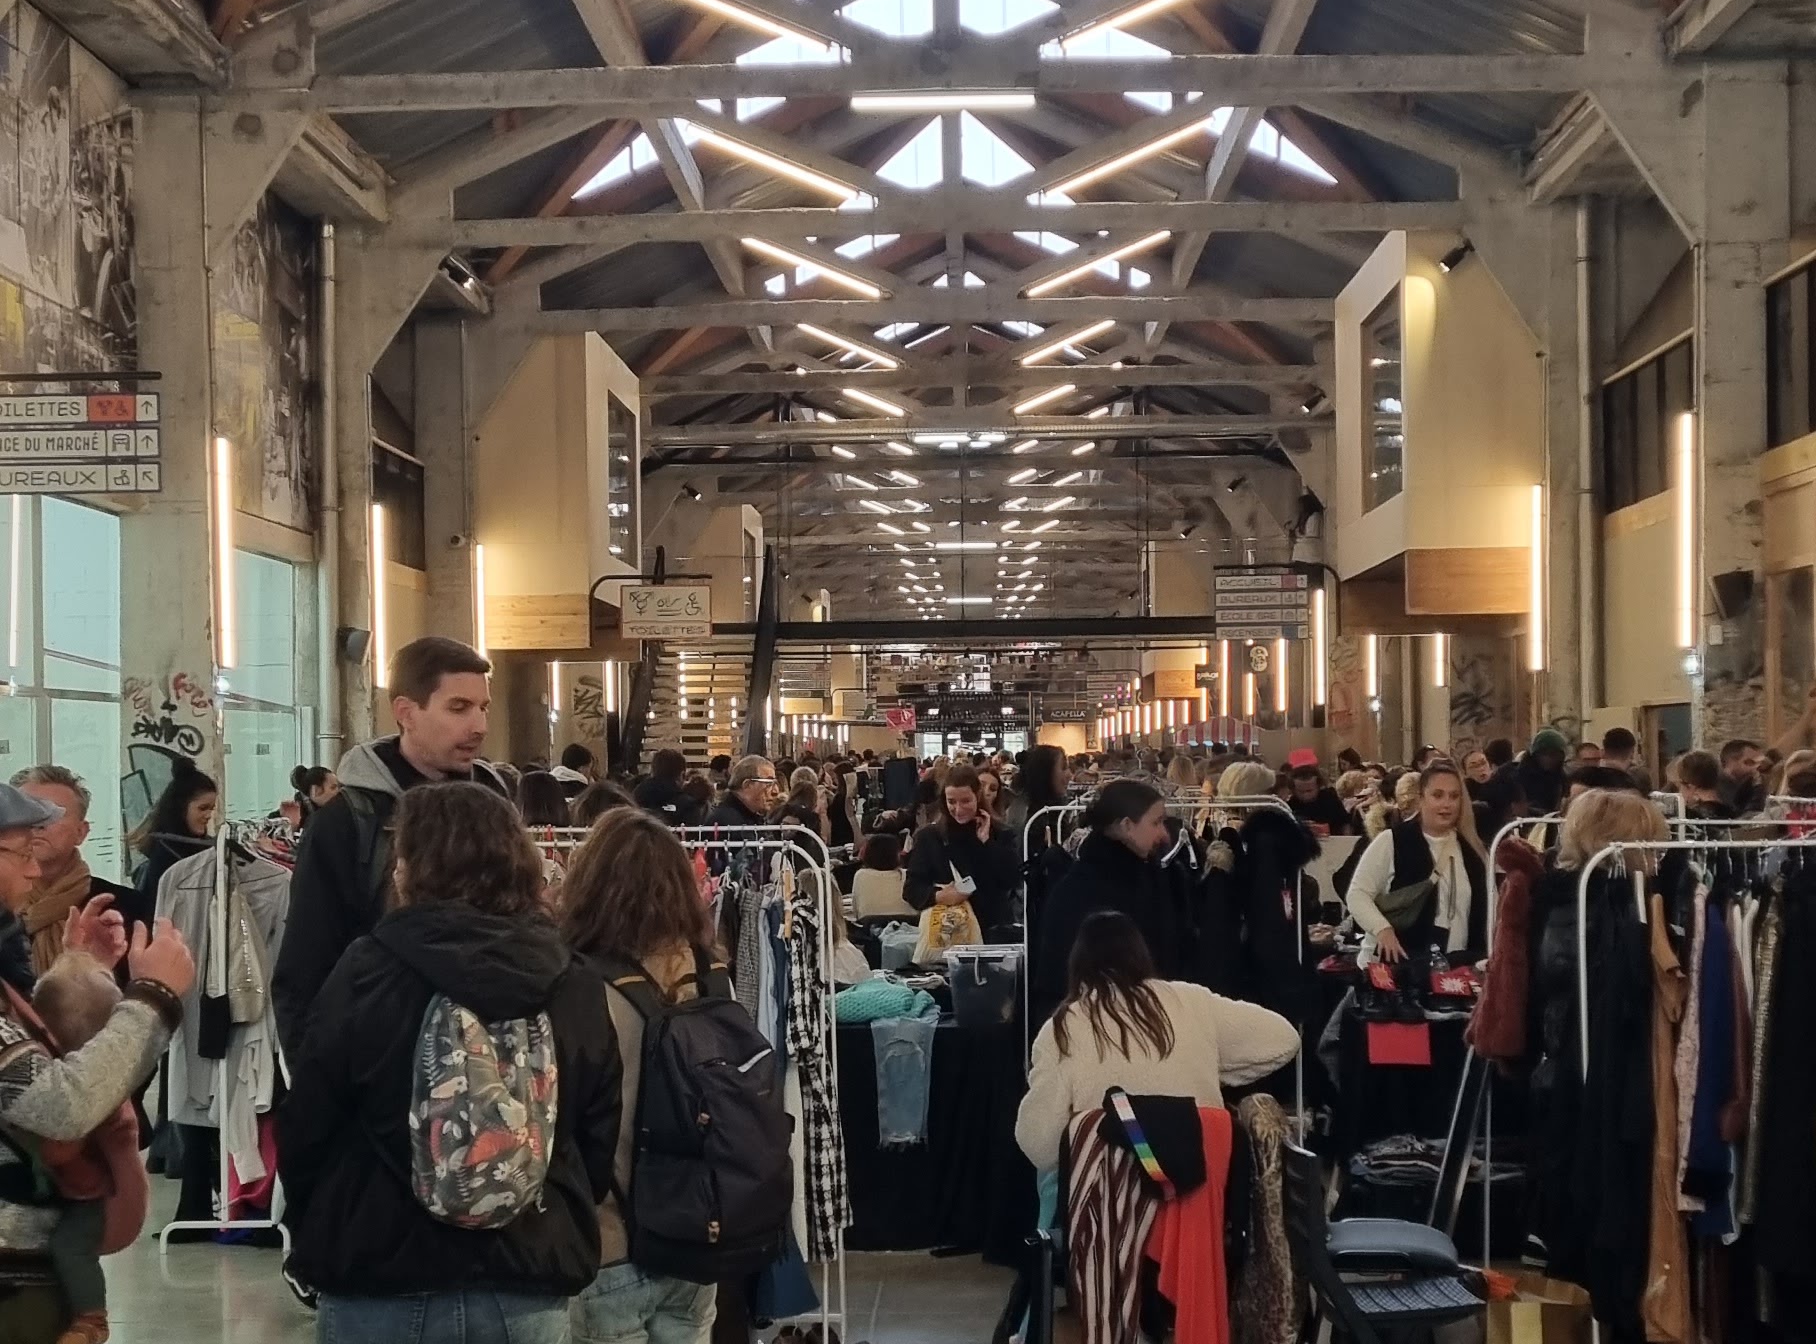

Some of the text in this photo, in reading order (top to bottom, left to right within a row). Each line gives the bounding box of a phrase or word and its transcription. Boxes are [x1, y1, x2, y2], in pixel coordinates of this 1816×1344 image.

[0, 402, 81, 417] ILETTES
[25, 437, 40, 452] DU
[46, 432, 98, 452] MARCHÉ
[1220, 578, 1277, 587] ACCUEIL
[1221, 595, 1278, 604] BUREAUX
[629, 625, 706, 635] TOILETTES
[1221, 628, 1279, 637] ASCENSEUR
